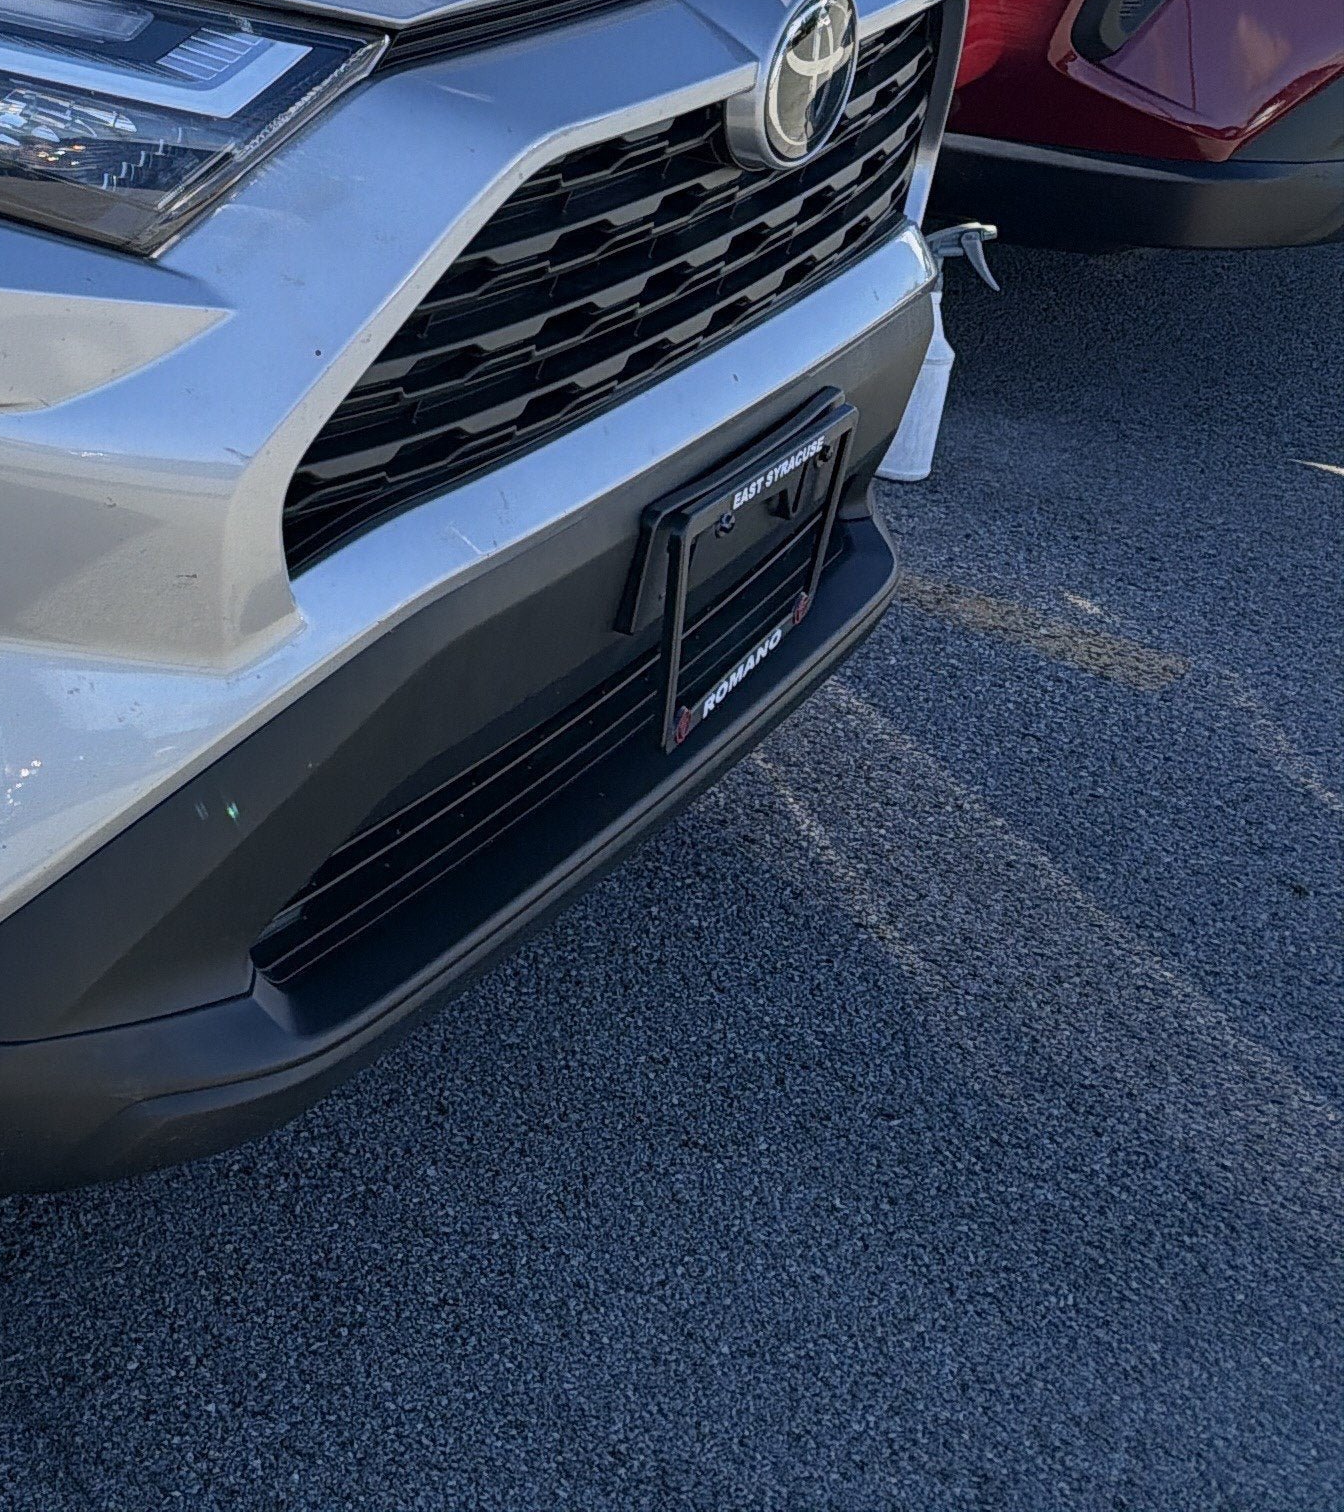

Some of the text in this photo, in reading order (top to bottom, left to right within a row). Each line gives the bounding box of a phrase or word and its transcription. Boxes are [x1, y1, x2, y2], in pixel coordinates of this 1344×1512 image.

[733, 435, 825, 510] EAST SYRACUSE
[702, 628, 782, 719] ROMANO
